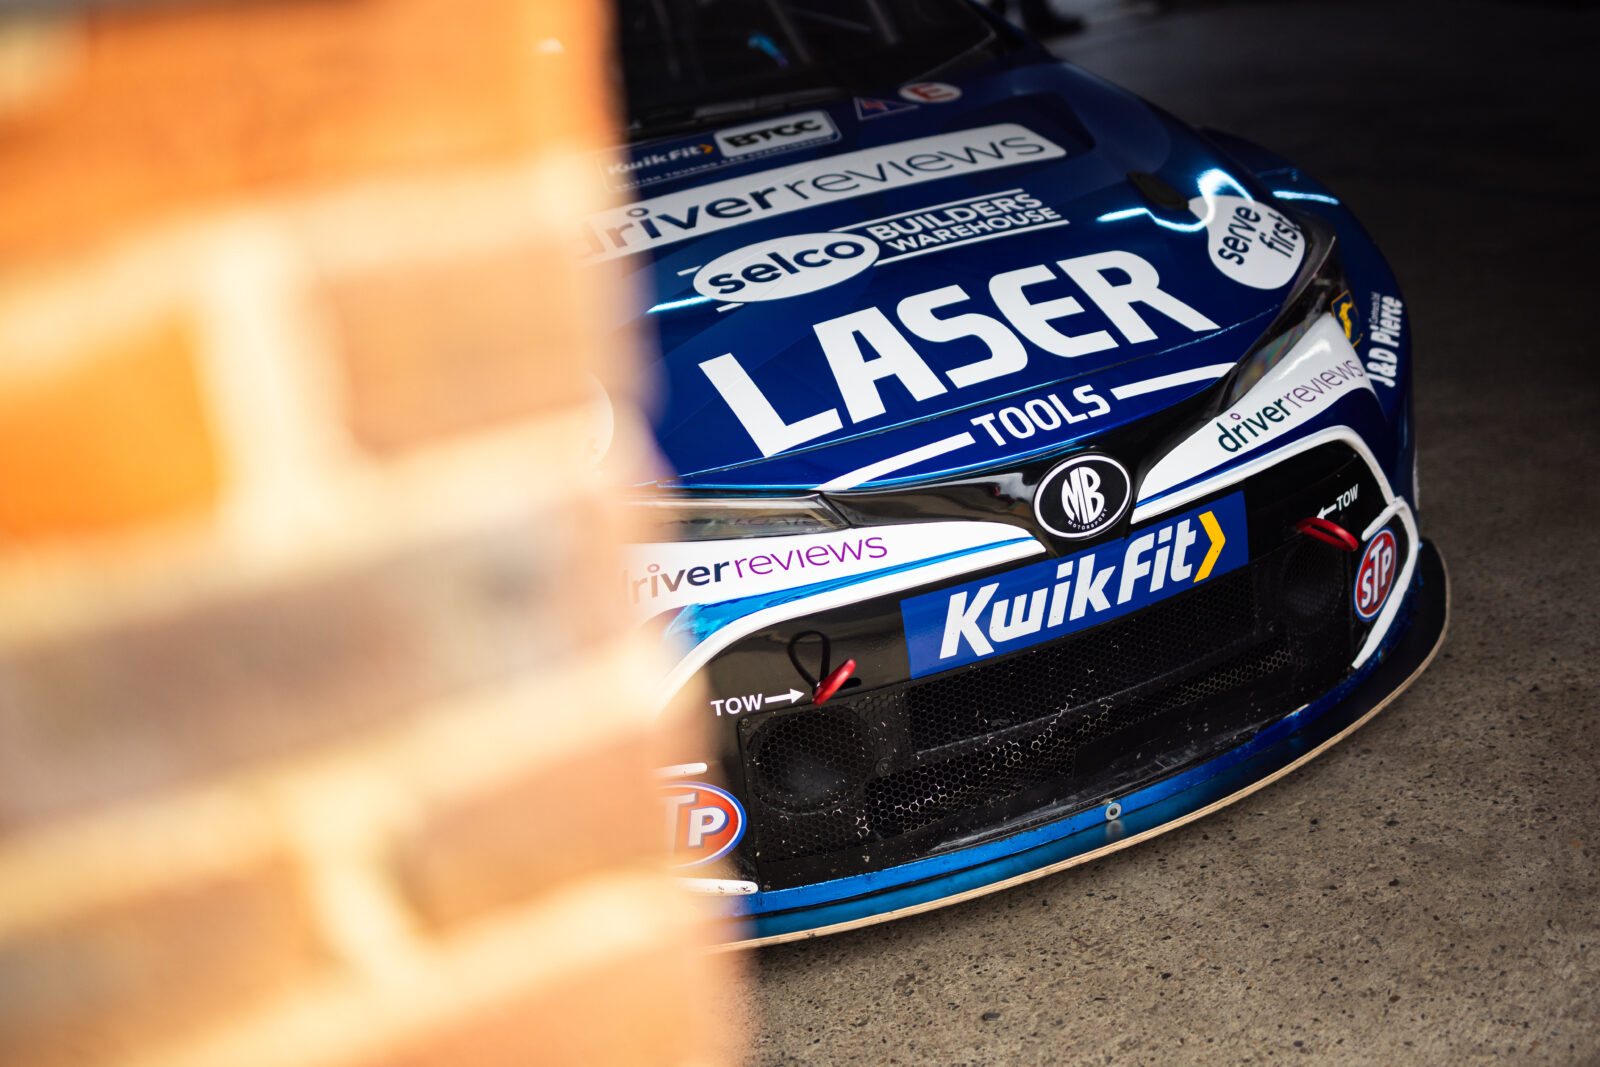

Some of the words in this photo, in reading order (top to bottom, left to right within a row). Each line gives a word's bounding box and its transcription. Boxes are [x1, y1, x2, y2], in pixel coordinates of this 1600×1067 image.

[906, 83, 955, 100] E
[722, 119, 822, 147] BTCC
[866, 194, 1042, 241] BUILDERS
[886, 207, 1061, 251] WAREHOUSE
[1217, 206, 1261, 266] serve
[1259, 212, 1300, 258] first
[708, 241, 865, 294] selco
[1370, 295, 1403, 348] Pierce
[698, 250, 1221, 457] LASER
[1365, 347, 1398, 388] J&D
[970, 384, 1111, 447] TOOLS
[1061, 466, 1105, 525] MB
[1067, 508, 1108, 530] MOTORSPORT
[1336, 484, 1358, 511] TOW
[1361, 536, 1393, 609] STP
[711, 693, 763, 717] TOW
[658, 791, 729, 857] TP
